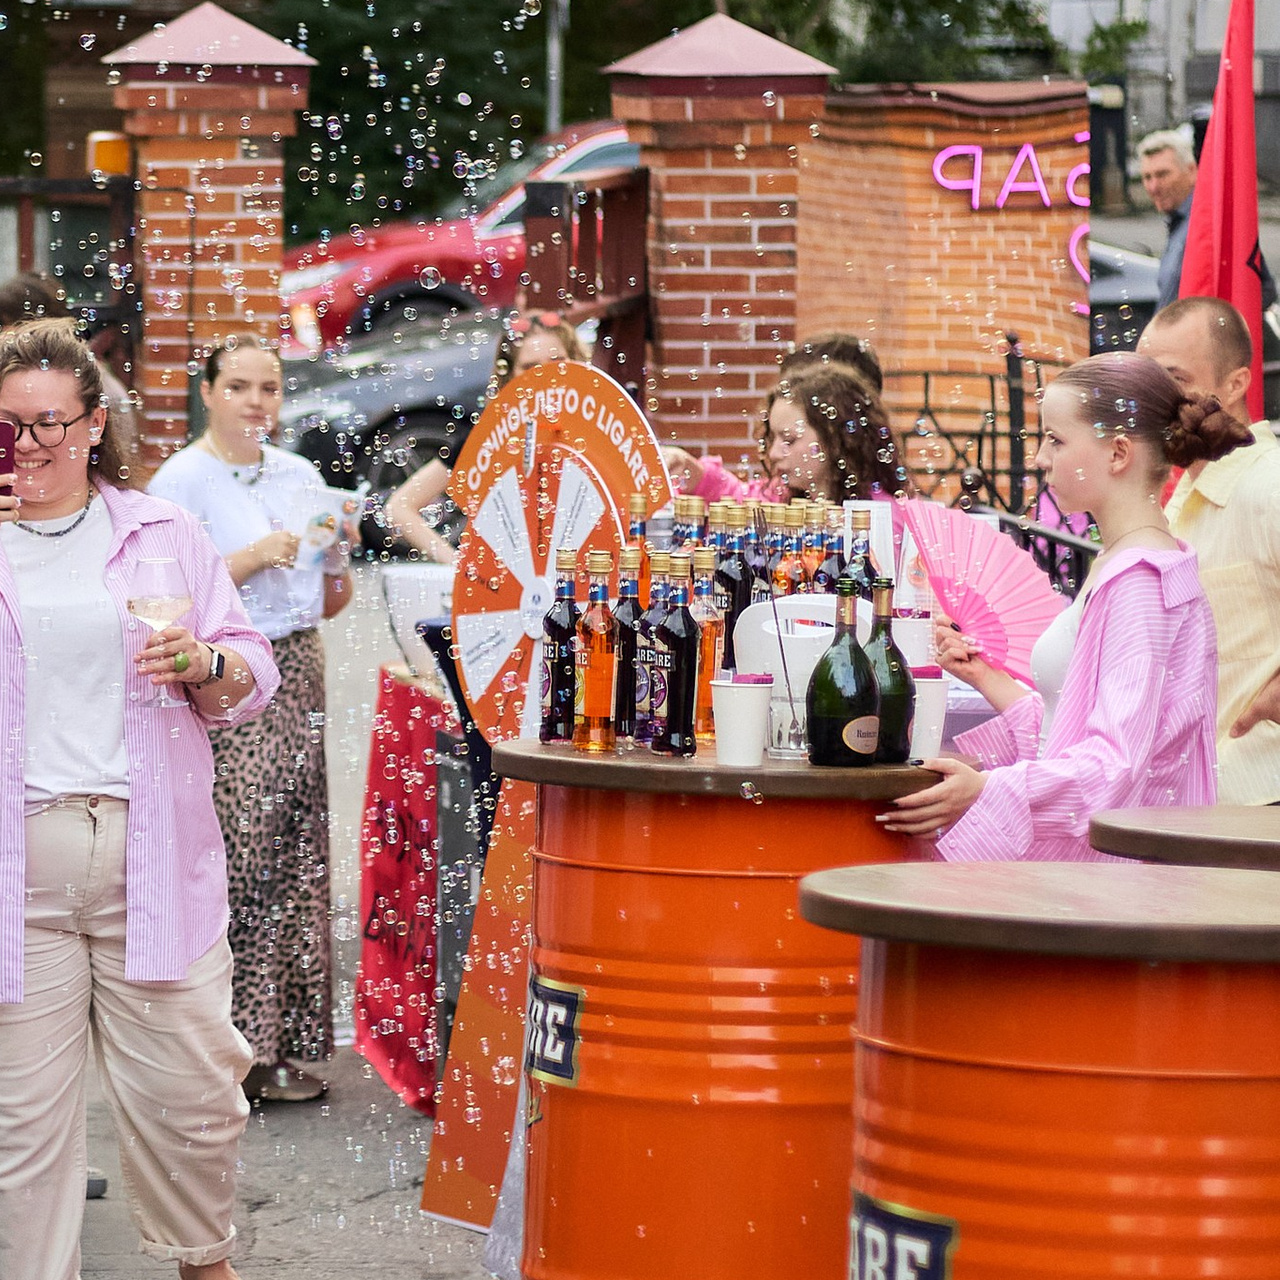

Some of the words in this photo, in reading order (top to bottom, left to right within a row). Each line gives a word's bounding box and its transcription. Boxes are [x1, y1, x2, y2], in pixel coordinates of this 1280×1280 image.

[467, 398, 530, 491] СОЧНОЕ
[533, 387, 579, 417] ЛЕТО
[596, 404, 649, 492] LIGARE
